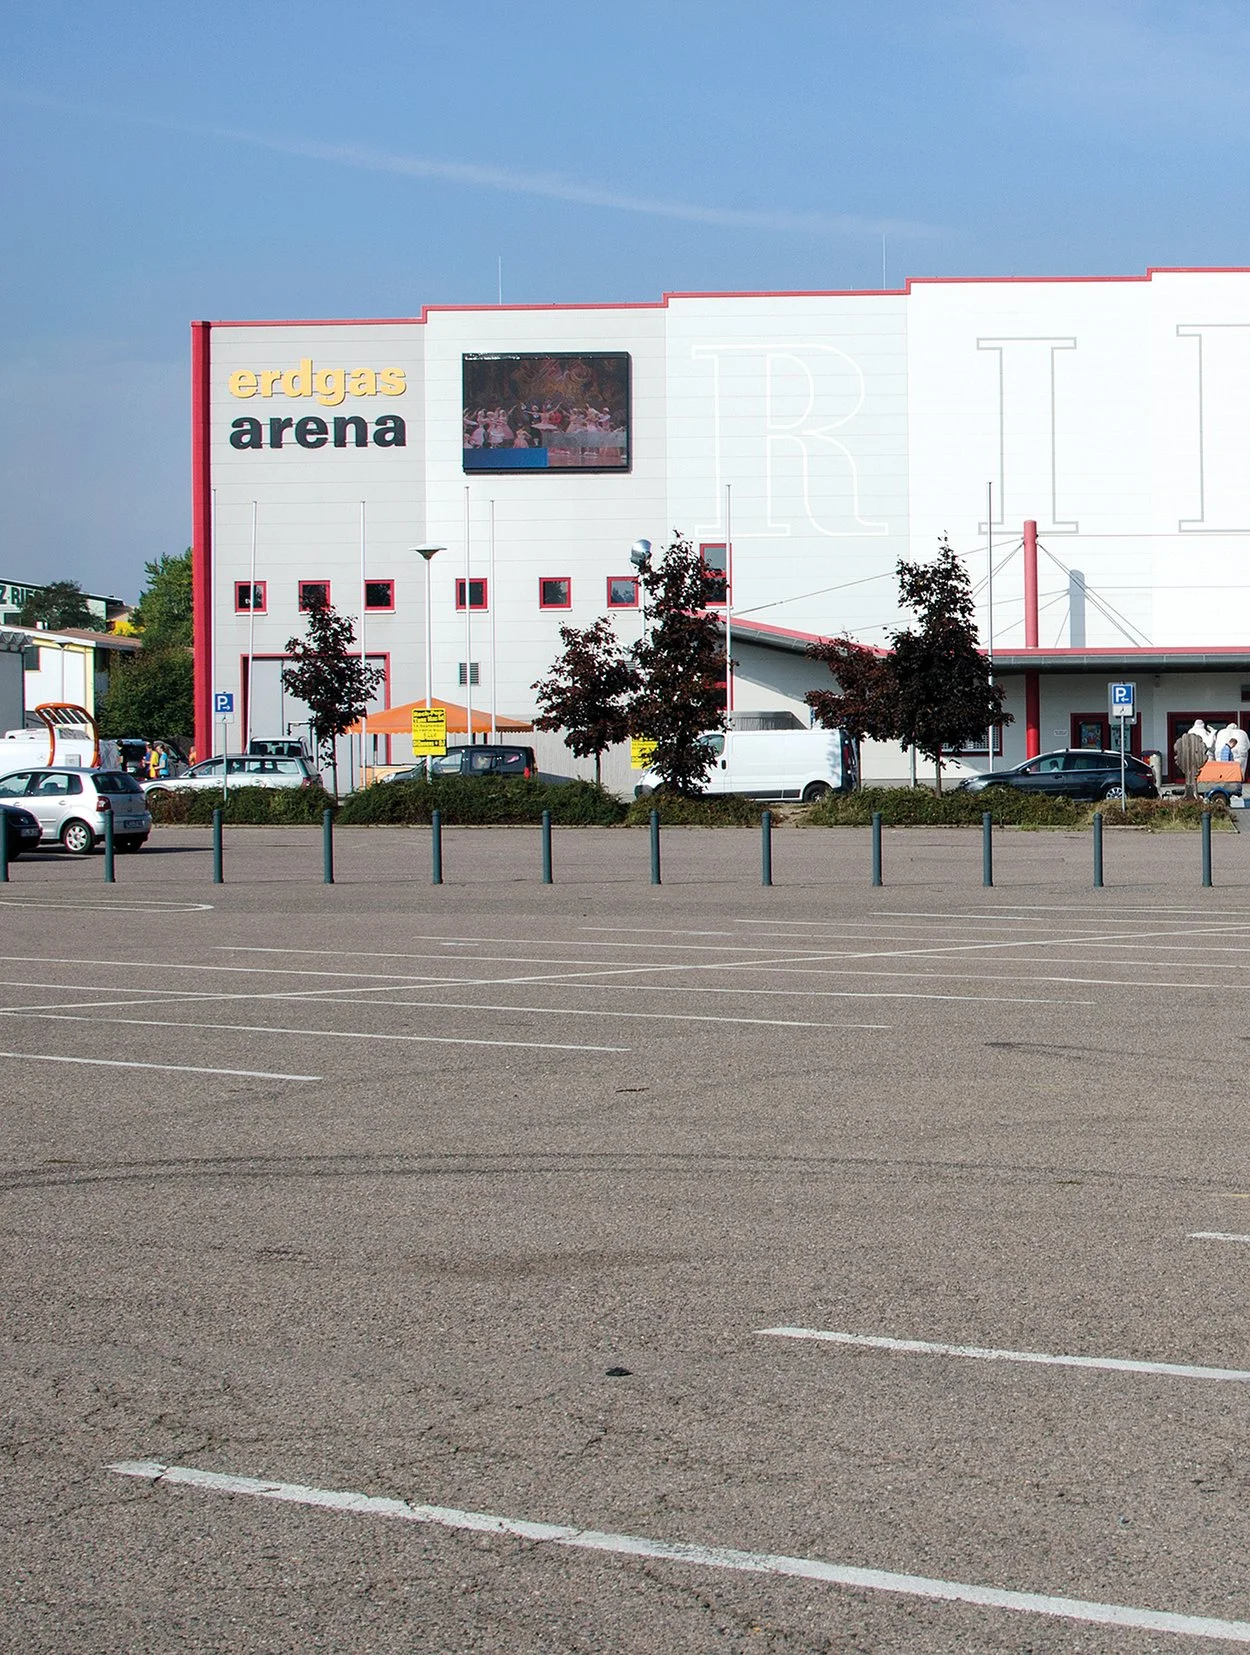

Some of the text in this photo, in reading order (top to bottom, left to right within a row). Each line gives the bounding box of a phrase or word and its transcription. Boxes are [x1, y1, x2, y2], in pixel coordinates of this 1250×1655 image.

[228, 358, 407, 407] erdgas
[229, 414, 407, 450] arena
[216, 695, 229, 711] P
[1115, 687, 1127, 703] P
